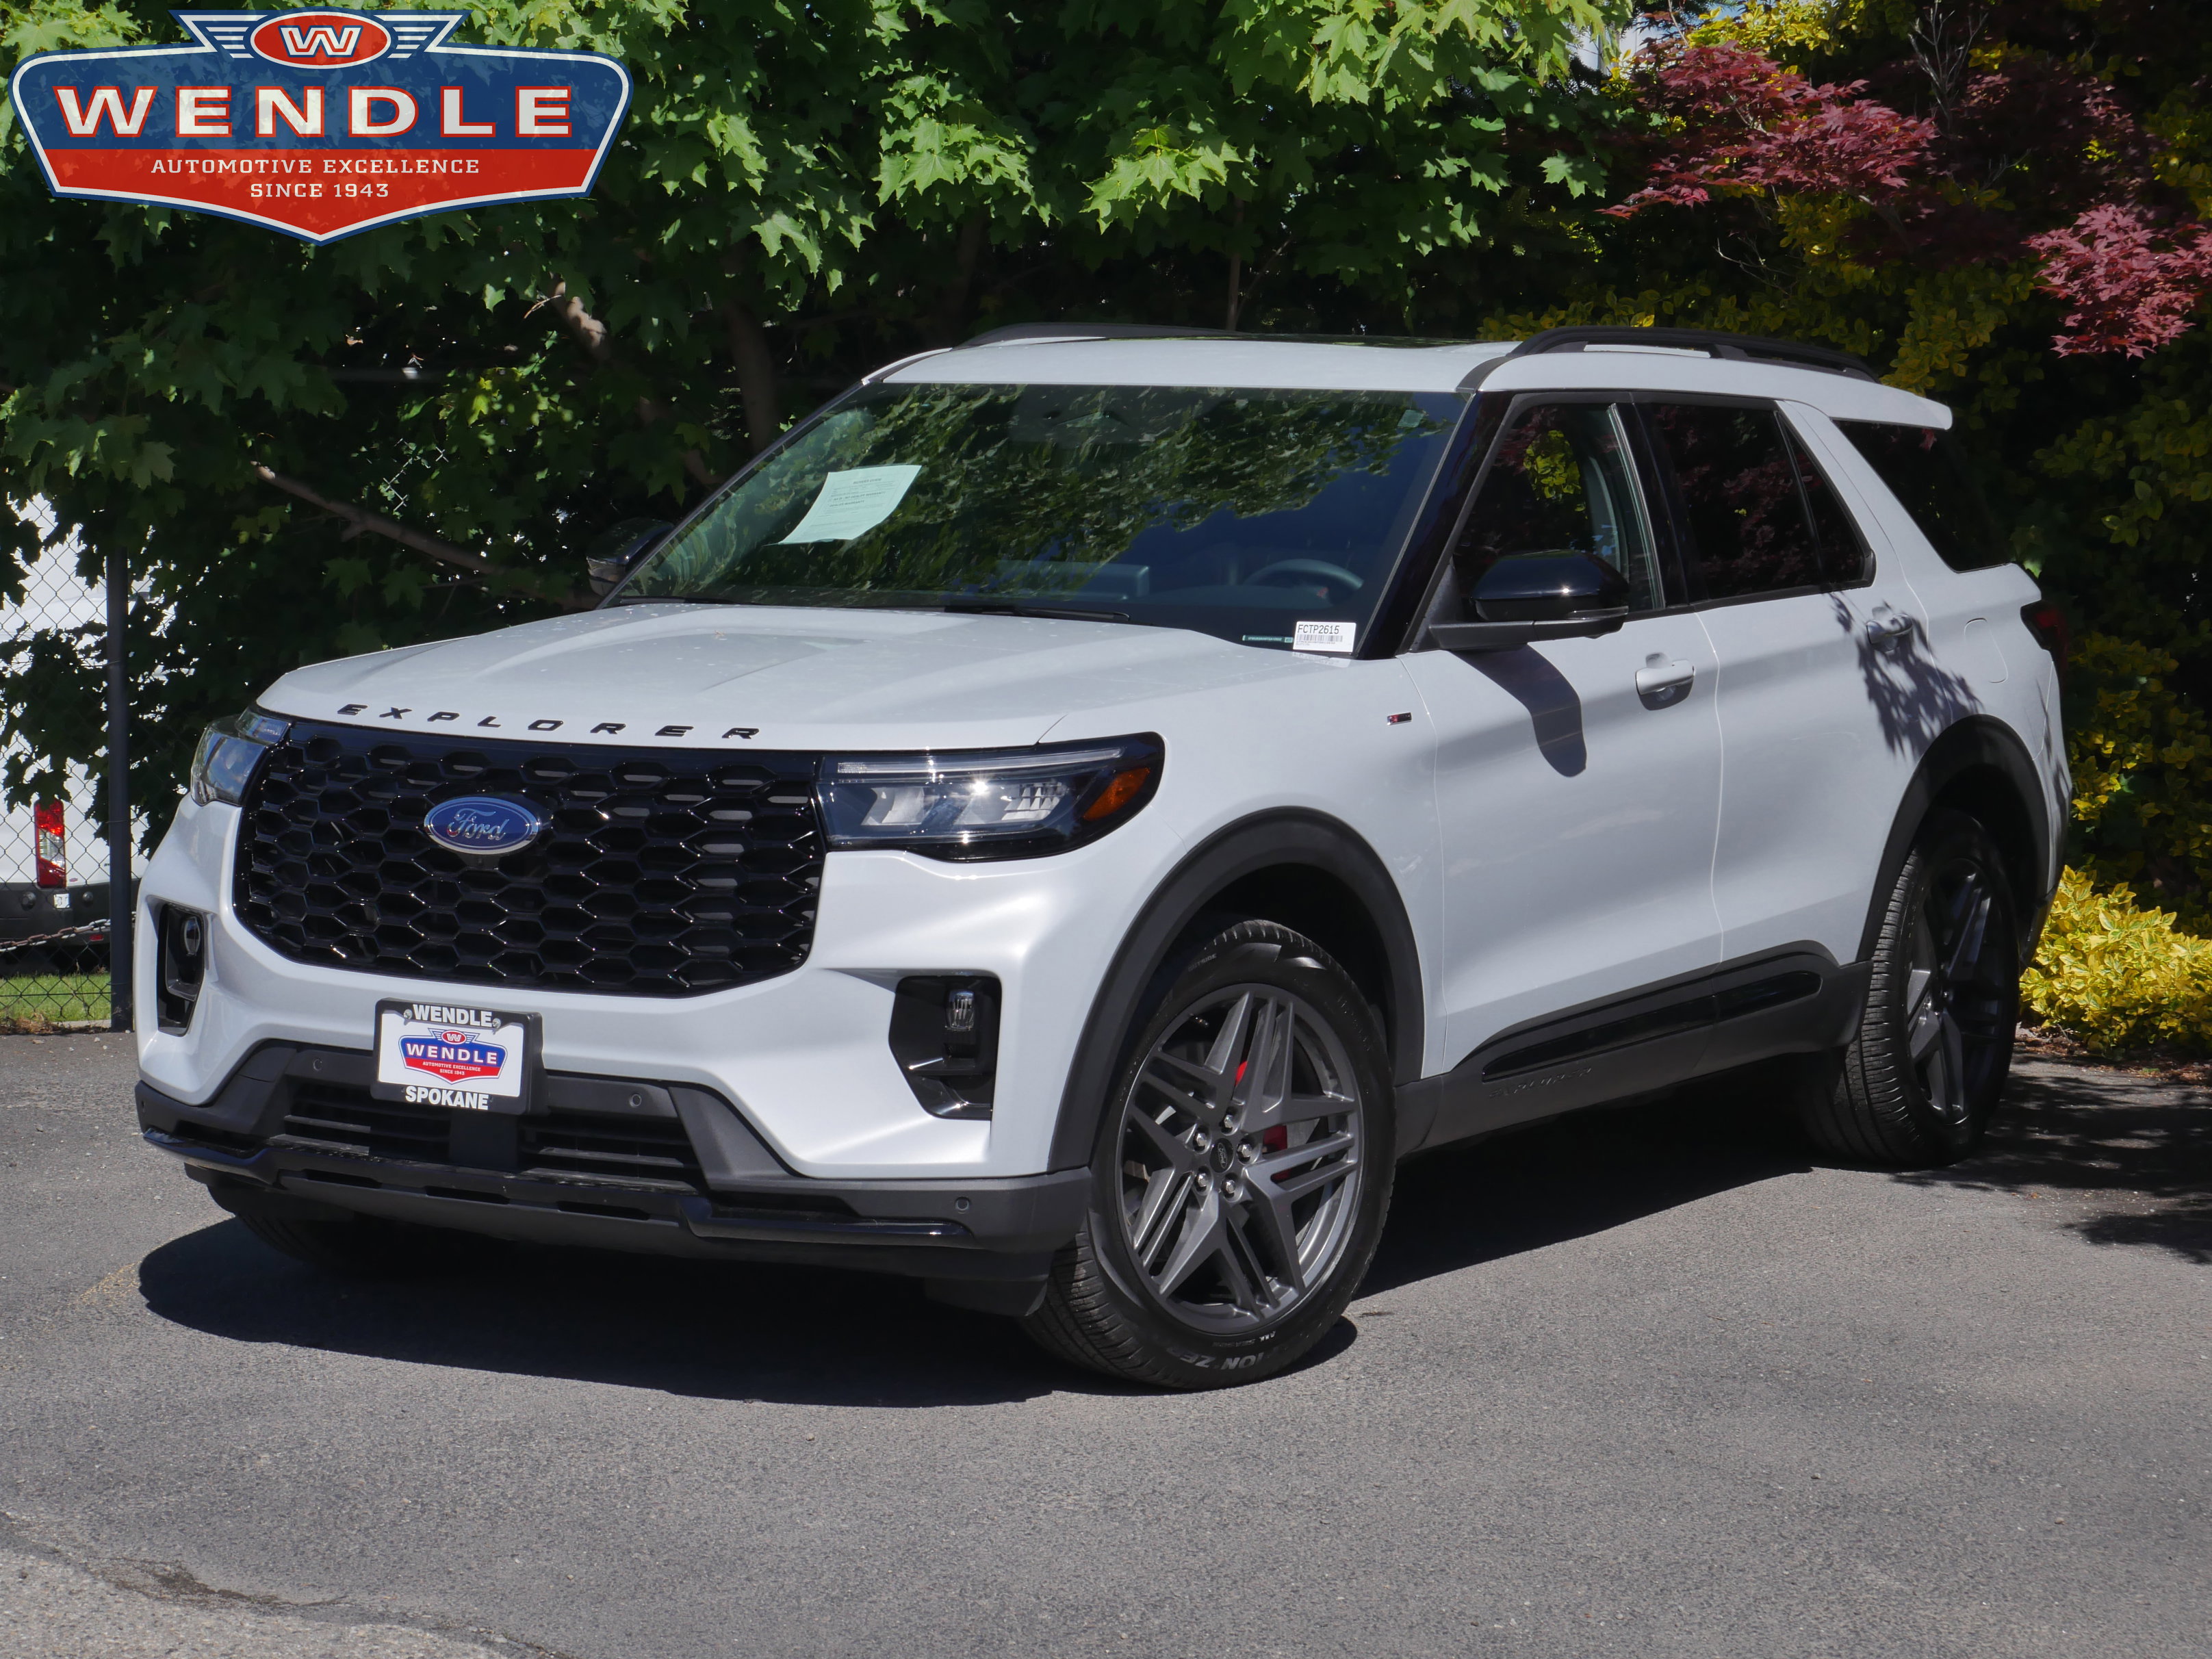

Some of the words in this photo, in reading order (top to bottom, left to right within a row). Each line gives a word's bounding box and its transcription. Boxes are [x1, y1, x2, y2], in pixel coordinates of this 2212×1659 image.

[1297, 624, 1340, 634] FCTP2615
[337, 703, 760, 740] EXPLORER
[446, 808, 511, 843] Ford
[413, 1004, 493, 1027] WENDLE
[406, 1043, 498, 1064] WENDLE
[405, 1085, 489, 1110] SPOKANE
